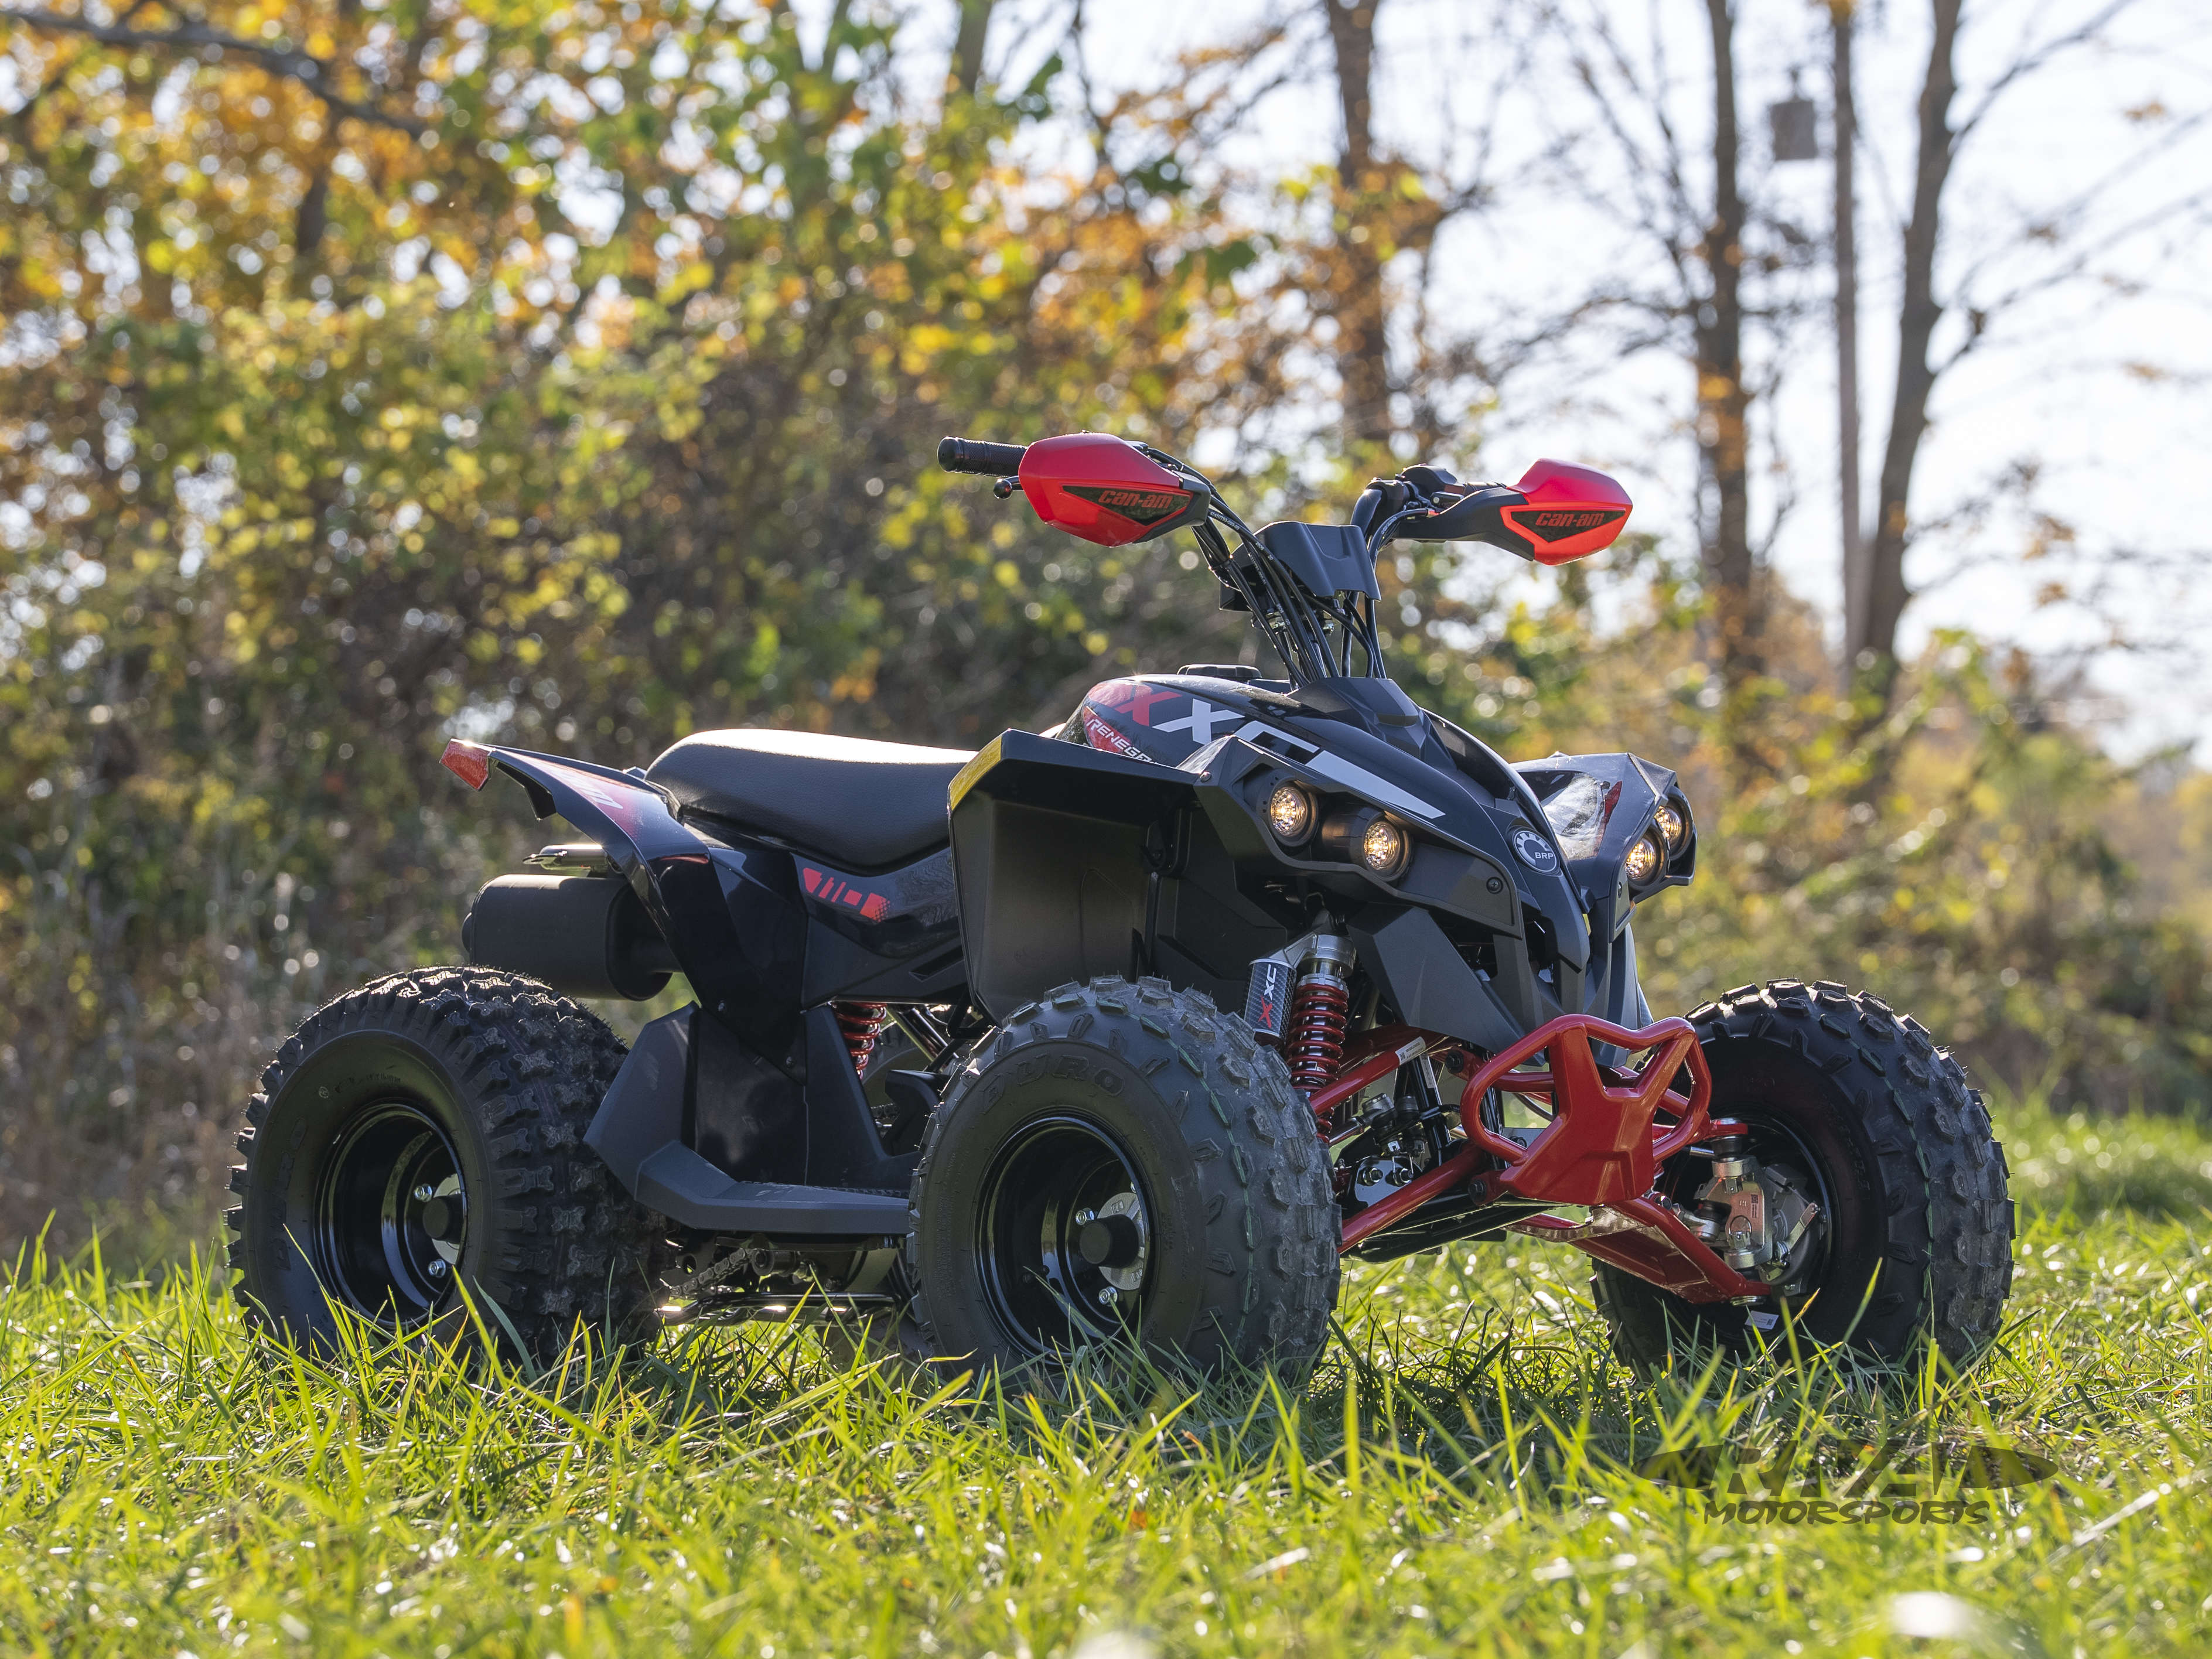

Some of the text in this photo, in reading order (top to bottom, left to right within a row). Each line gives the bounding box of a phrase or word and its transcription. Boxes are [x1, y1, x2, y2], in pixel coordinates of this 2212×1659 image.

[1098, 490, 1173, 508] can-am
[1535, 513, 1605, 527] can-am
[1086, 719, 1158, 764] RENEGA
[979, 1053, 1125, 1115] DURO
